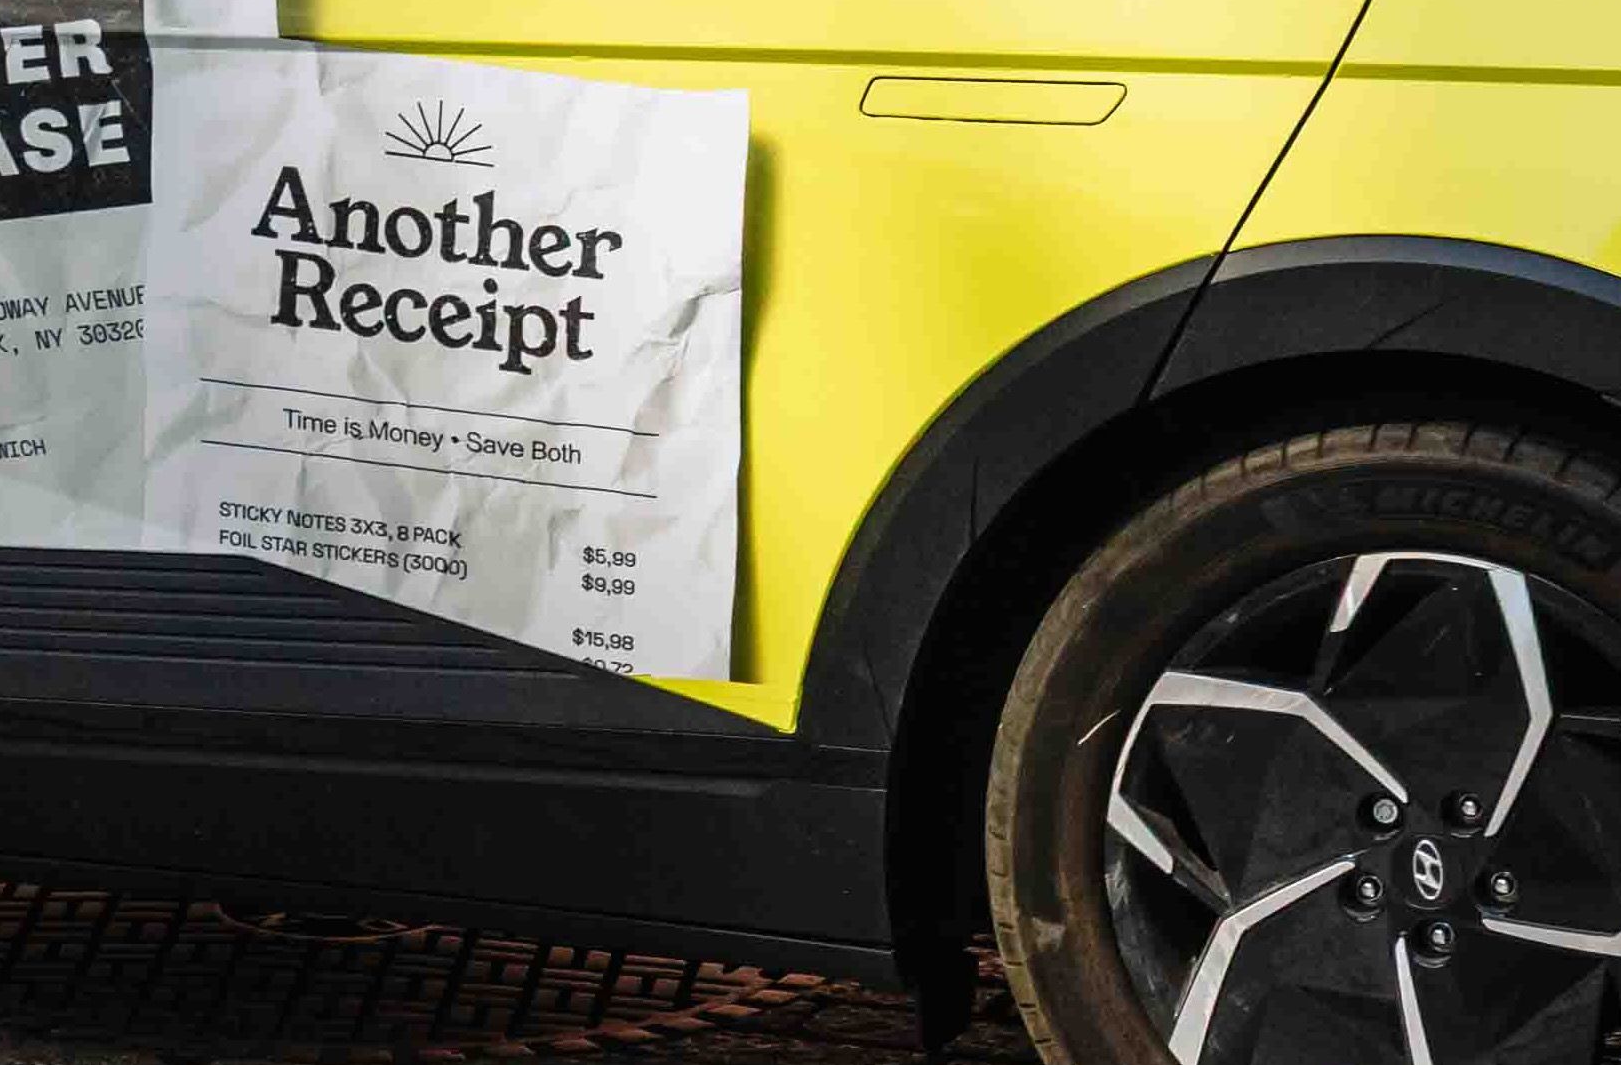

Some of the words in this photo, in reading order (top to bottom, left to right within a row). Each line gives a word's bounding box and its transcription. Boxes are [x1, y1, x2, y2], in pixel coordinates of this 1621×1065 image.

[251, 165, 623, 280] Another
[271, 248, 595, 375] Receipt
[35, 328, 64, 351] NY
[282, 407, 337, 435] Time
[344, 416, 362, 439] is
[369, 419, 444, 453] Money
[466, 431, 525, 458] Save
[531, 441, 582, 465] Both
[218, 501, 283, 524] STICKY
[287, 508, 347, 533] NOTES
[350, 517, 394, 542] 3X3,
[396, 525, 410, 542] 8
[412, 526, 463, 549] PACK
[219, 529, 258, 550] FOIL
[261, 535, 307, 557] STAR
[312, 542, 399, 568] STICKERS
[403, 553, 469, 581] (3000)
